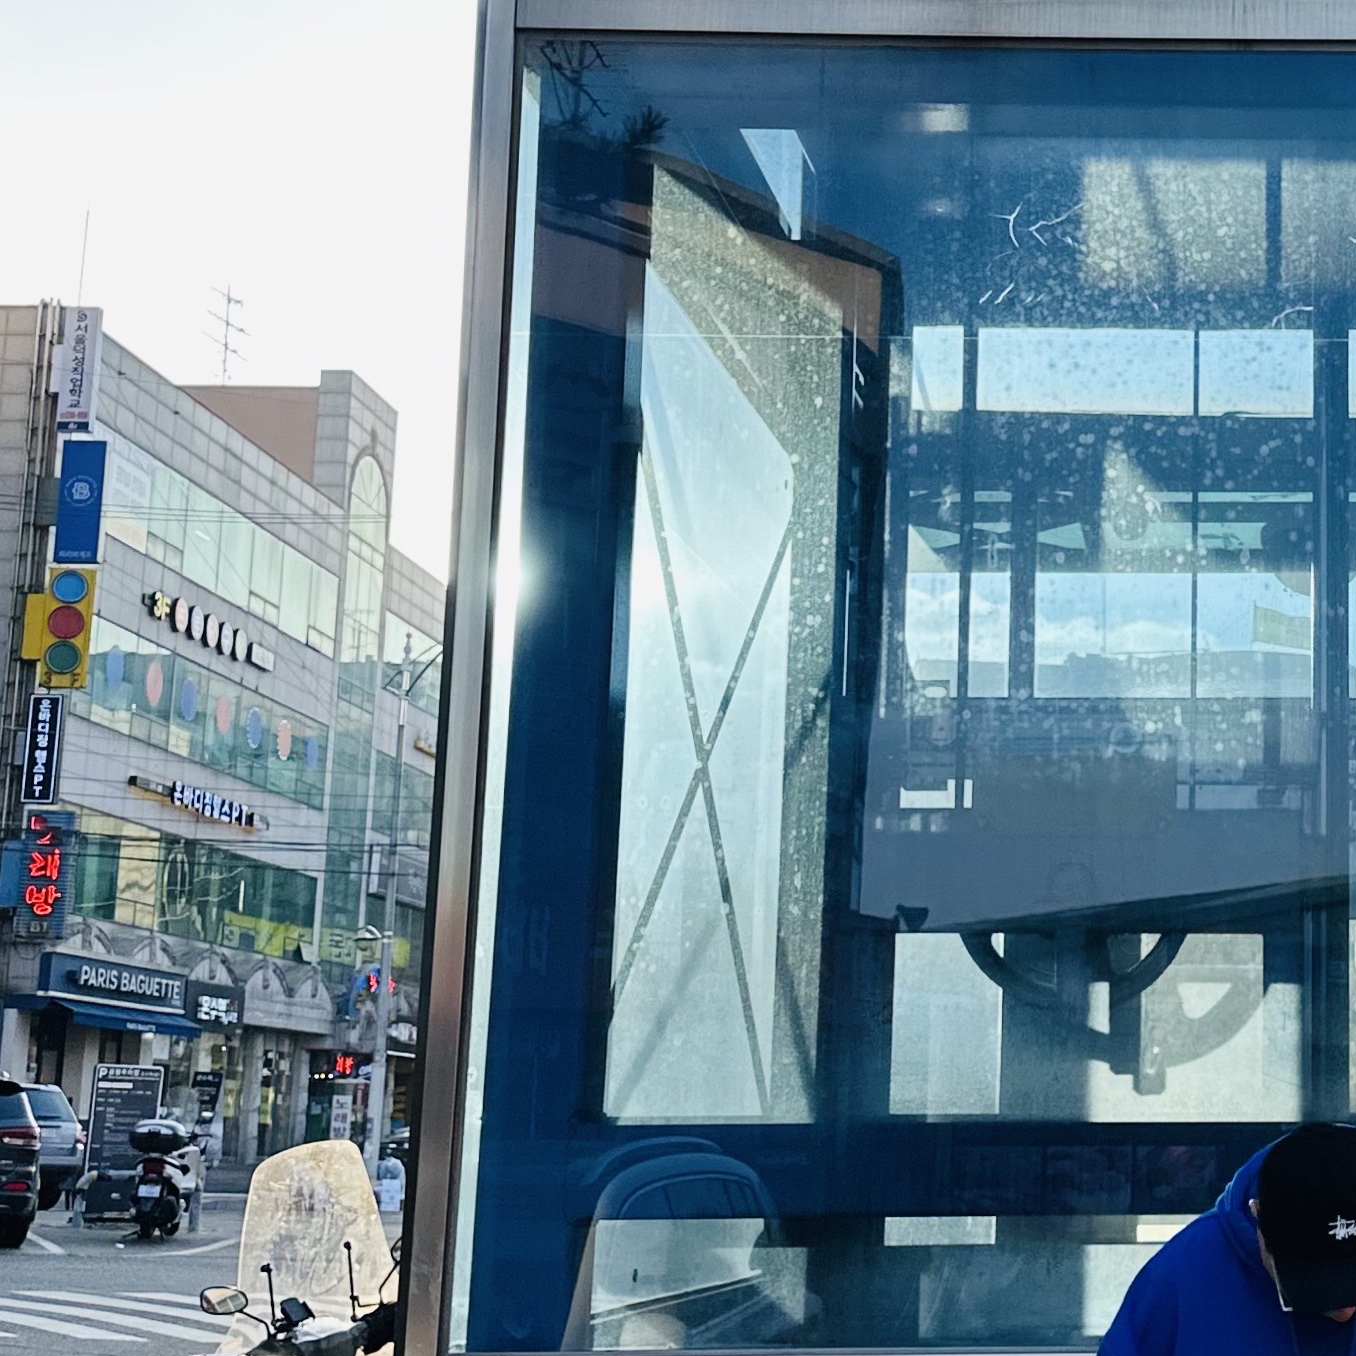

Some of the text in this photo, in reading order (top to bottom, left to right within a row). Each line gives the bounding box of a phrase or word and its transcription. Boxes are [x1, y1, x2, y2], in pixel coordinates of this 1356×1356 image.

[154, 591, 171, 621] 3F
[79, 965, 181, 1000] PARIS BAGUETTE
[333, 1098, 348, 1137] 노래방
